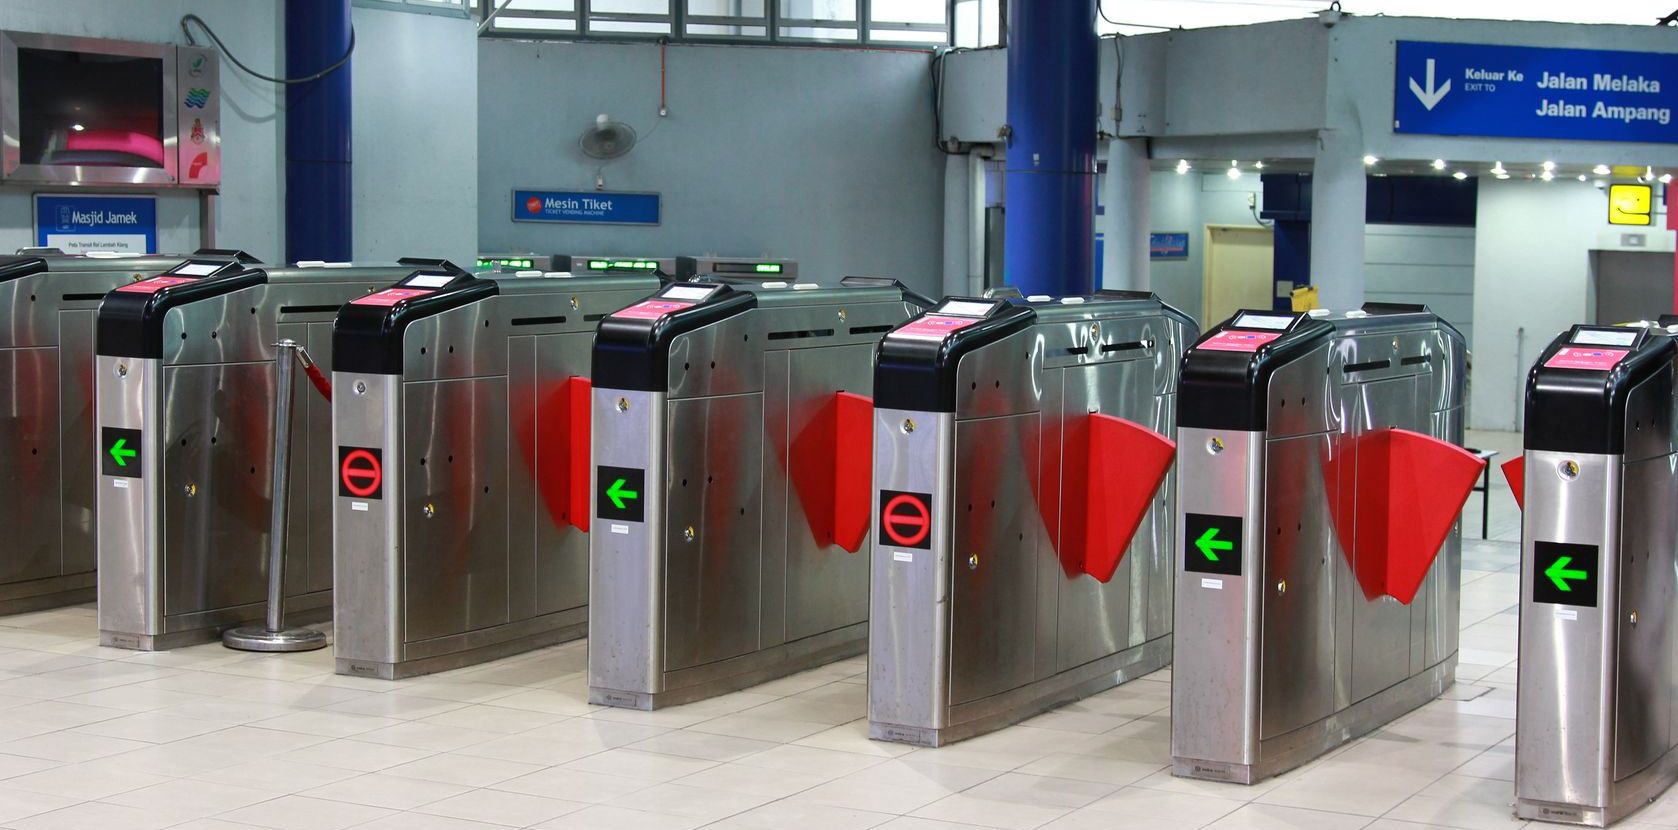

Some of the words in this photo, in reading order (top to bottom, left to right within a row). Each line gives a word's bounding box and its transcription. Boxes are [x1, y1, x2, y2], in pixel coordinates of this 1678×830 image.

[1465, 68, 1504, 81] Keluar
[1507, 70, 1524, 82] Ke
[1537, 72, 1587, 90] Jalan
[1593, 74, 1660, 93] Melaka
[1465, 83, 1483, 91] EXIT
[1485, 84, 1496, 92] TO
[1536, 99, 1586, 117] Jalan
[1592, 101, 1671, 124] Ampang
[544, 197, 578, 209] Mesin
[582, 198, 613, 211] Tiket
[72, 211, 103, 227] Masjid
[106, 211, 137, 224] Jamek
